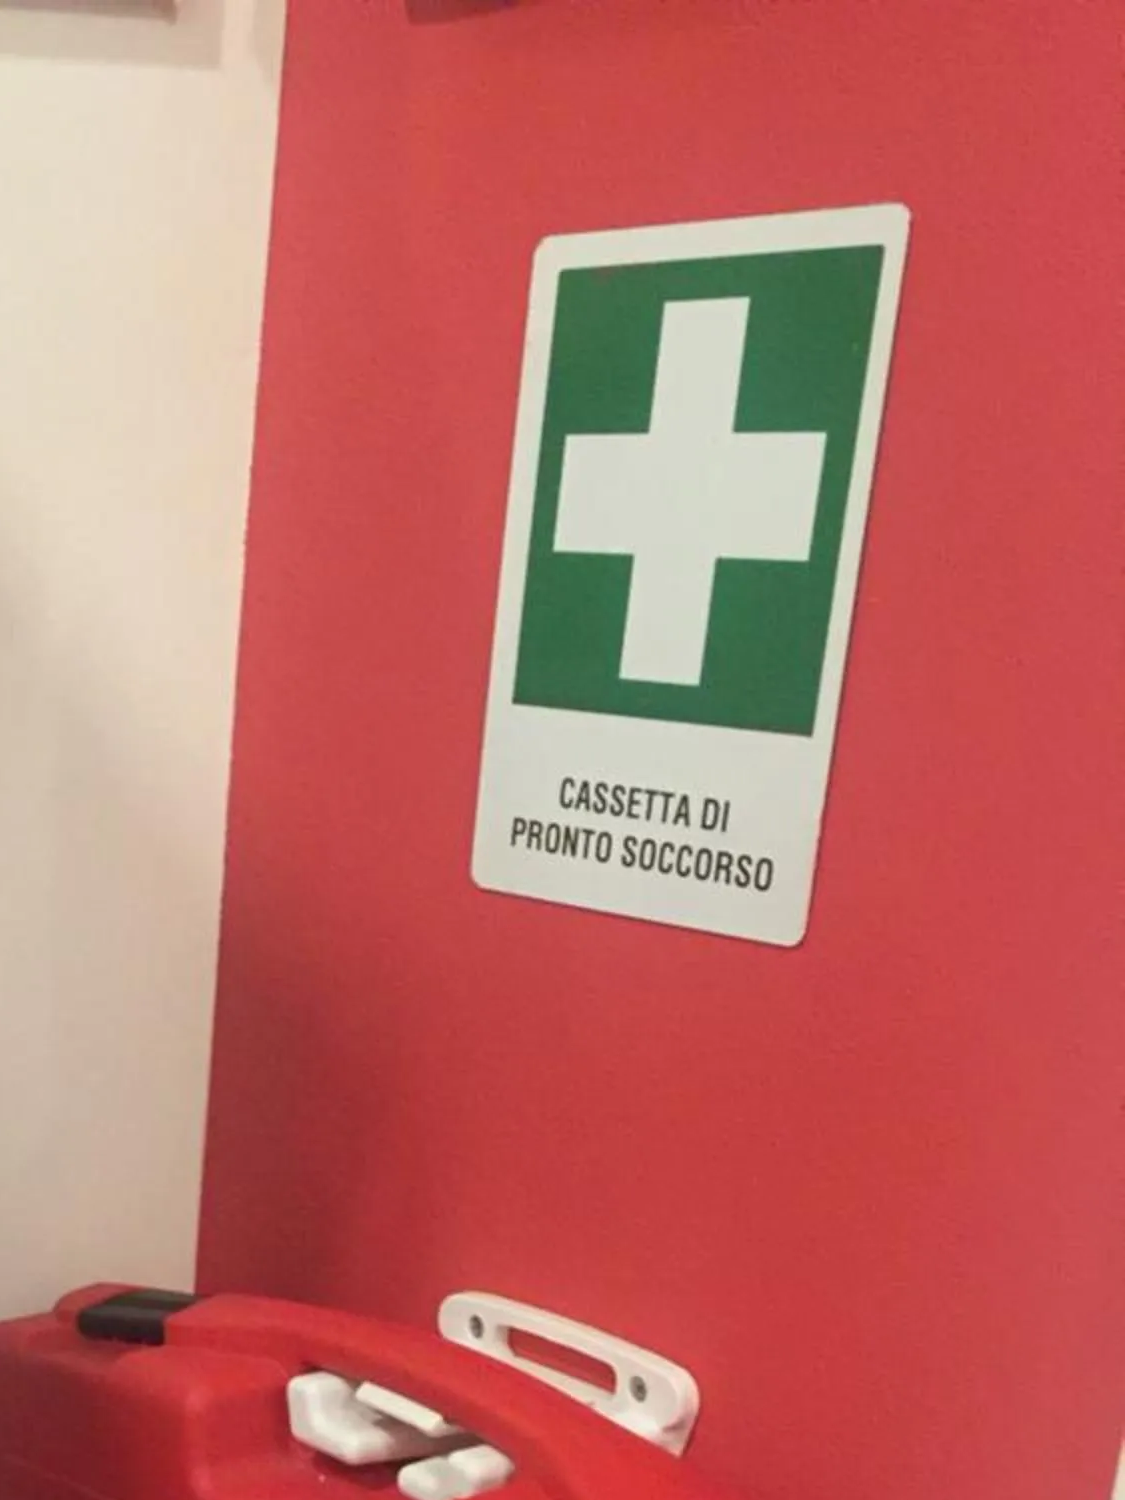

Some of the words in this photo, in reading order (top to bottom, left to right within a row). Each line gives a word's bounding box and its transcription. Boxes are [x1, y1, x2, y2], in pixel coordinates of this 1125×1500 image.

[559, 776, 691, 828] CASSETTA
[699, 797, 731, 833] DI
[510, 817, 613, 863] PRONTO
[621, 835, 775, 892] SOCCORSO
